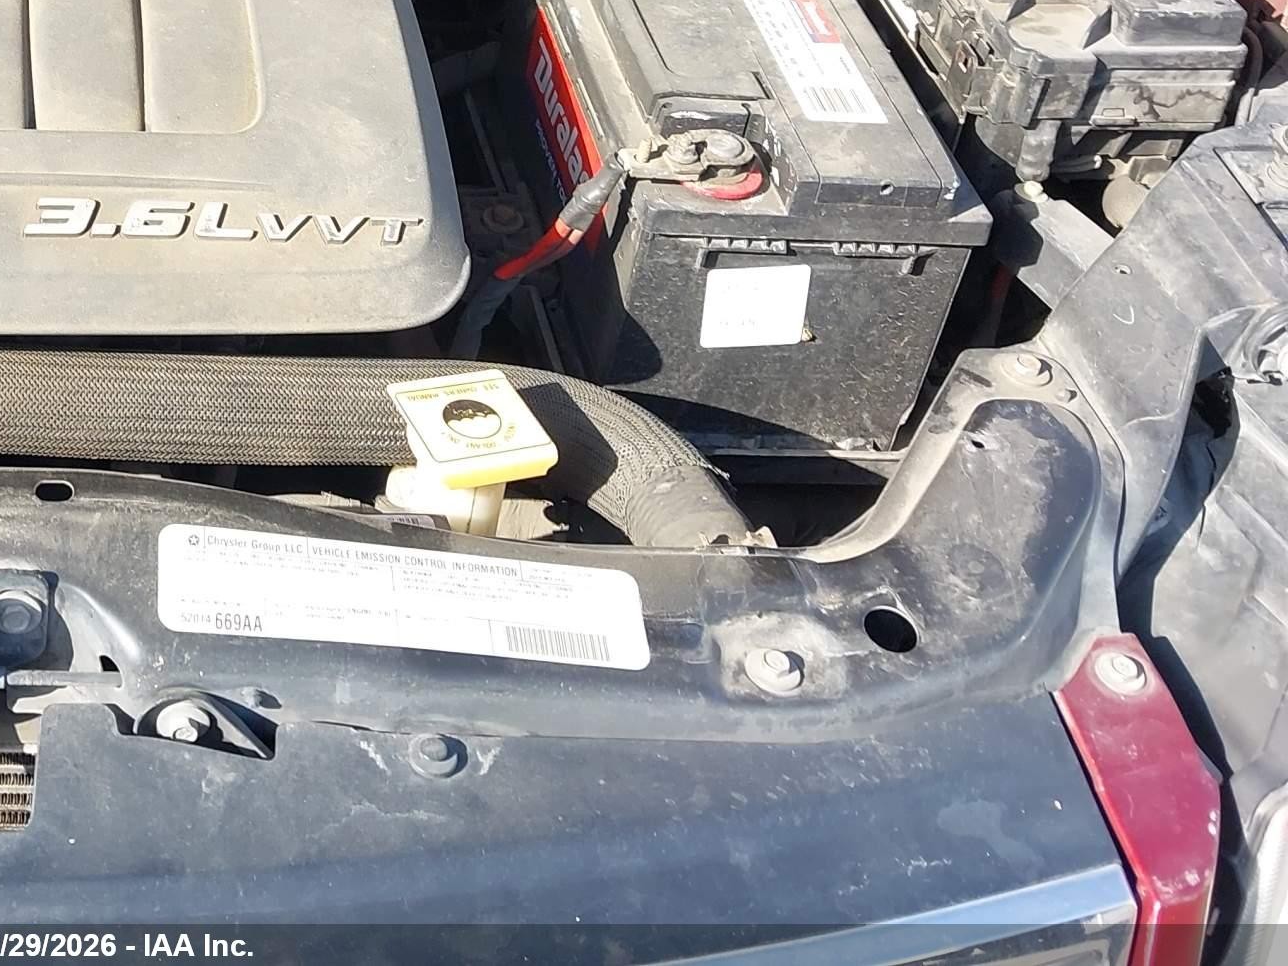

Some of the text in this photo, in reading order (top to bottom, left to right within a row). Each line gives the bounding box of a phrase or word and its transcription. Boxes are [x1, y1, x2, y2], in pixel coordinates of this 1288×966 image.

[23, 196, 426, 247] 3.6L VVT
[206, 534, 304, 555] Chrysler Group LLC
[312, 545, 352, 560] VEHICLE
[355, 549, 402, 565] EMISSION
[404, 555, 449, 571] CONTROL
[452, 561, 519, 578] INFORMATION
[214, 611, 264, 634] 669AA
